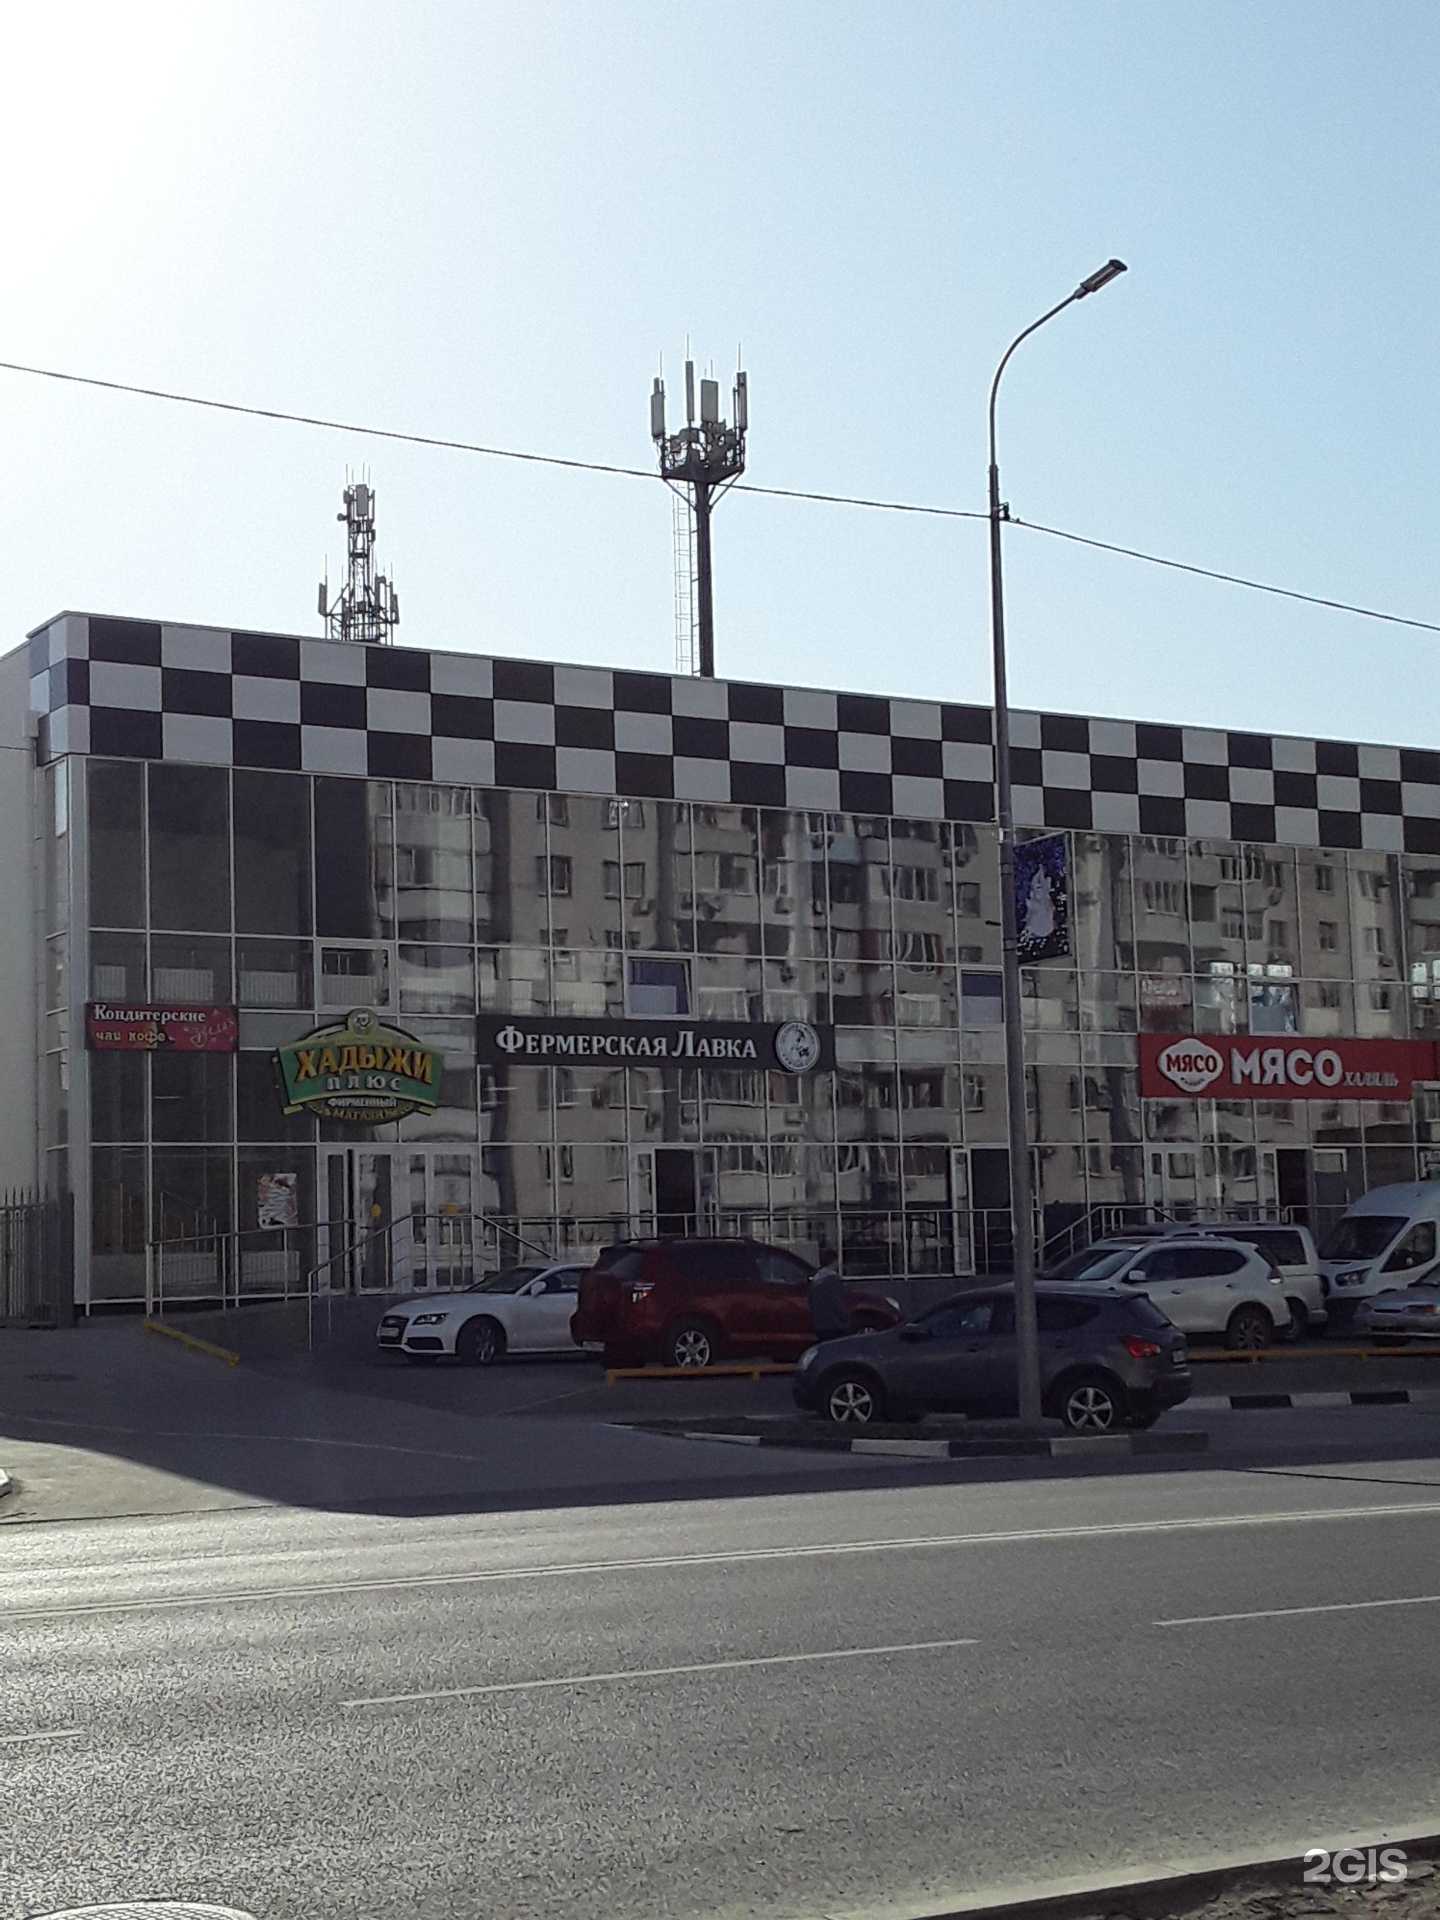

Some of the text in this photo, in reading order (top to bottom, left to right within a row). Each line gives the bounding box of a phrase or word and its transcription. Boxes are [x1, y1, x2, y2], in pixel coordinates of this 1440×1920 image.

[94, 1004, 207, 1024] Кондитерские
[128, 1028, 166, 1044] кофе
[495, 1025, 668, 1057] ФЕРМЕРСКАЯ
[672, 1030, 757, 1058] ЛАВКА
[295, 1045, 433, 1084] ХАДЫЖИ
[1166, 1053, 1217, 1073] МЯСО
[1231, 1048, 1343, 1087] МЯСО
[326, 1074, 402, 1091] ПЛЮС
